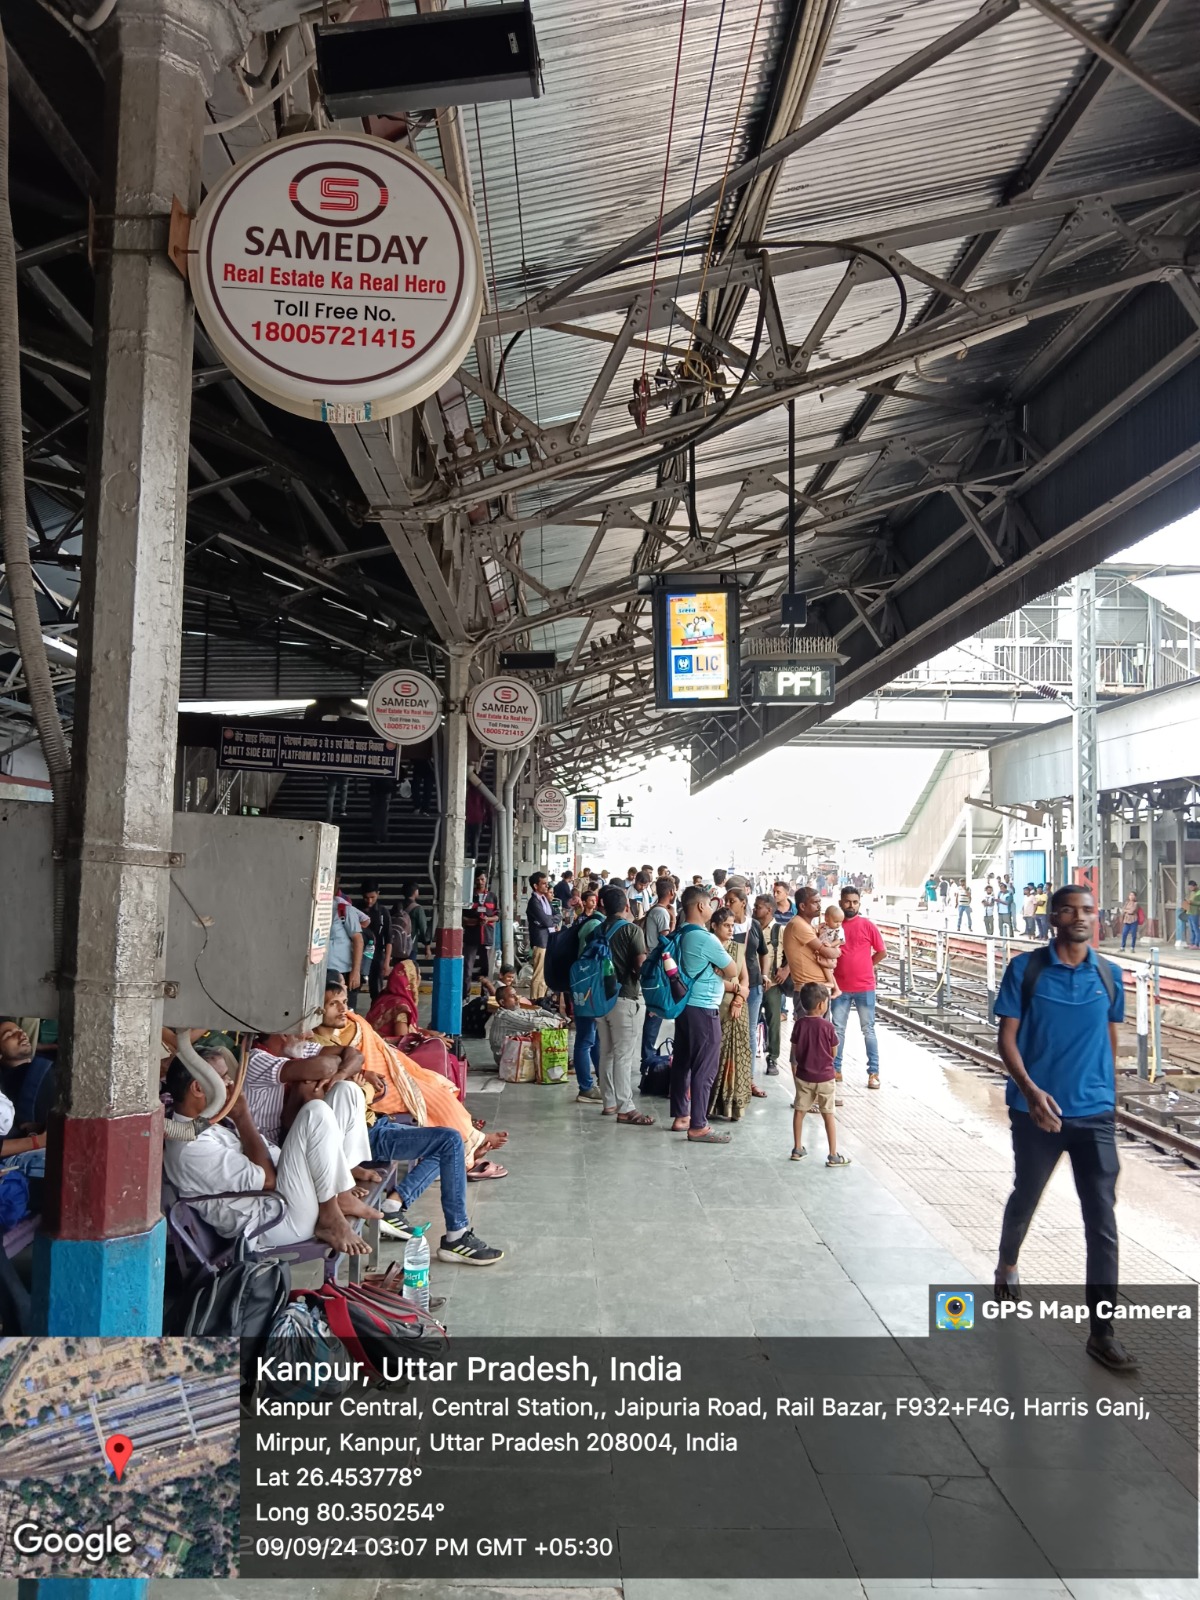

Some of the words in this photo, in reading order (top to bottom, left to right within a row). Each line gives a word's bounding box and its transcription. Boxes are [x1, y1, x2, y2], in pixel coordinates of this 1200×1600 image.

[244, 226, 428, 265] SAMEDAY
[223, 263, 264, 284] Real
[270, 267, 325, 288] Estate
[331, 271, 353, 290] Ka
[360, 273, 398, 292] Real
[405, 274, 446, 294] Hero
[274, 299, 309, 317] Toll
[315, 302, 358, 320] Free
[364, 305, 396, 322] No.
[251, 320, 416, 349] 18005721415
[696, 655, 719, 671] LIC
[778, 671, 822, 696] PF1
[381, 697, 429, 708] SAMEDAY
[481, 703, 529, 714] SAMEDAY
[384, 722, 426, 731] 18005721415
[483, 728, 525, 736] 18005721415
[223, 745, 244, 756] CANTT
[246, 747, 260, 757] SIDE
[262, 748, 276, 758] EXIT
[281, 750, 311, 760] PLATFORM
[313, 751, 320, 761] NO
[322, 752, 326, 762] 2
[327, 753, 334, 762] TO
[335, 753, 340, 763] 9
[341, 753, 352, 763] AND
[353, 754, 366, 764] CITY
[367, 755, 380, 765] SIDE
[382, 756, 395, 766] EXIT
